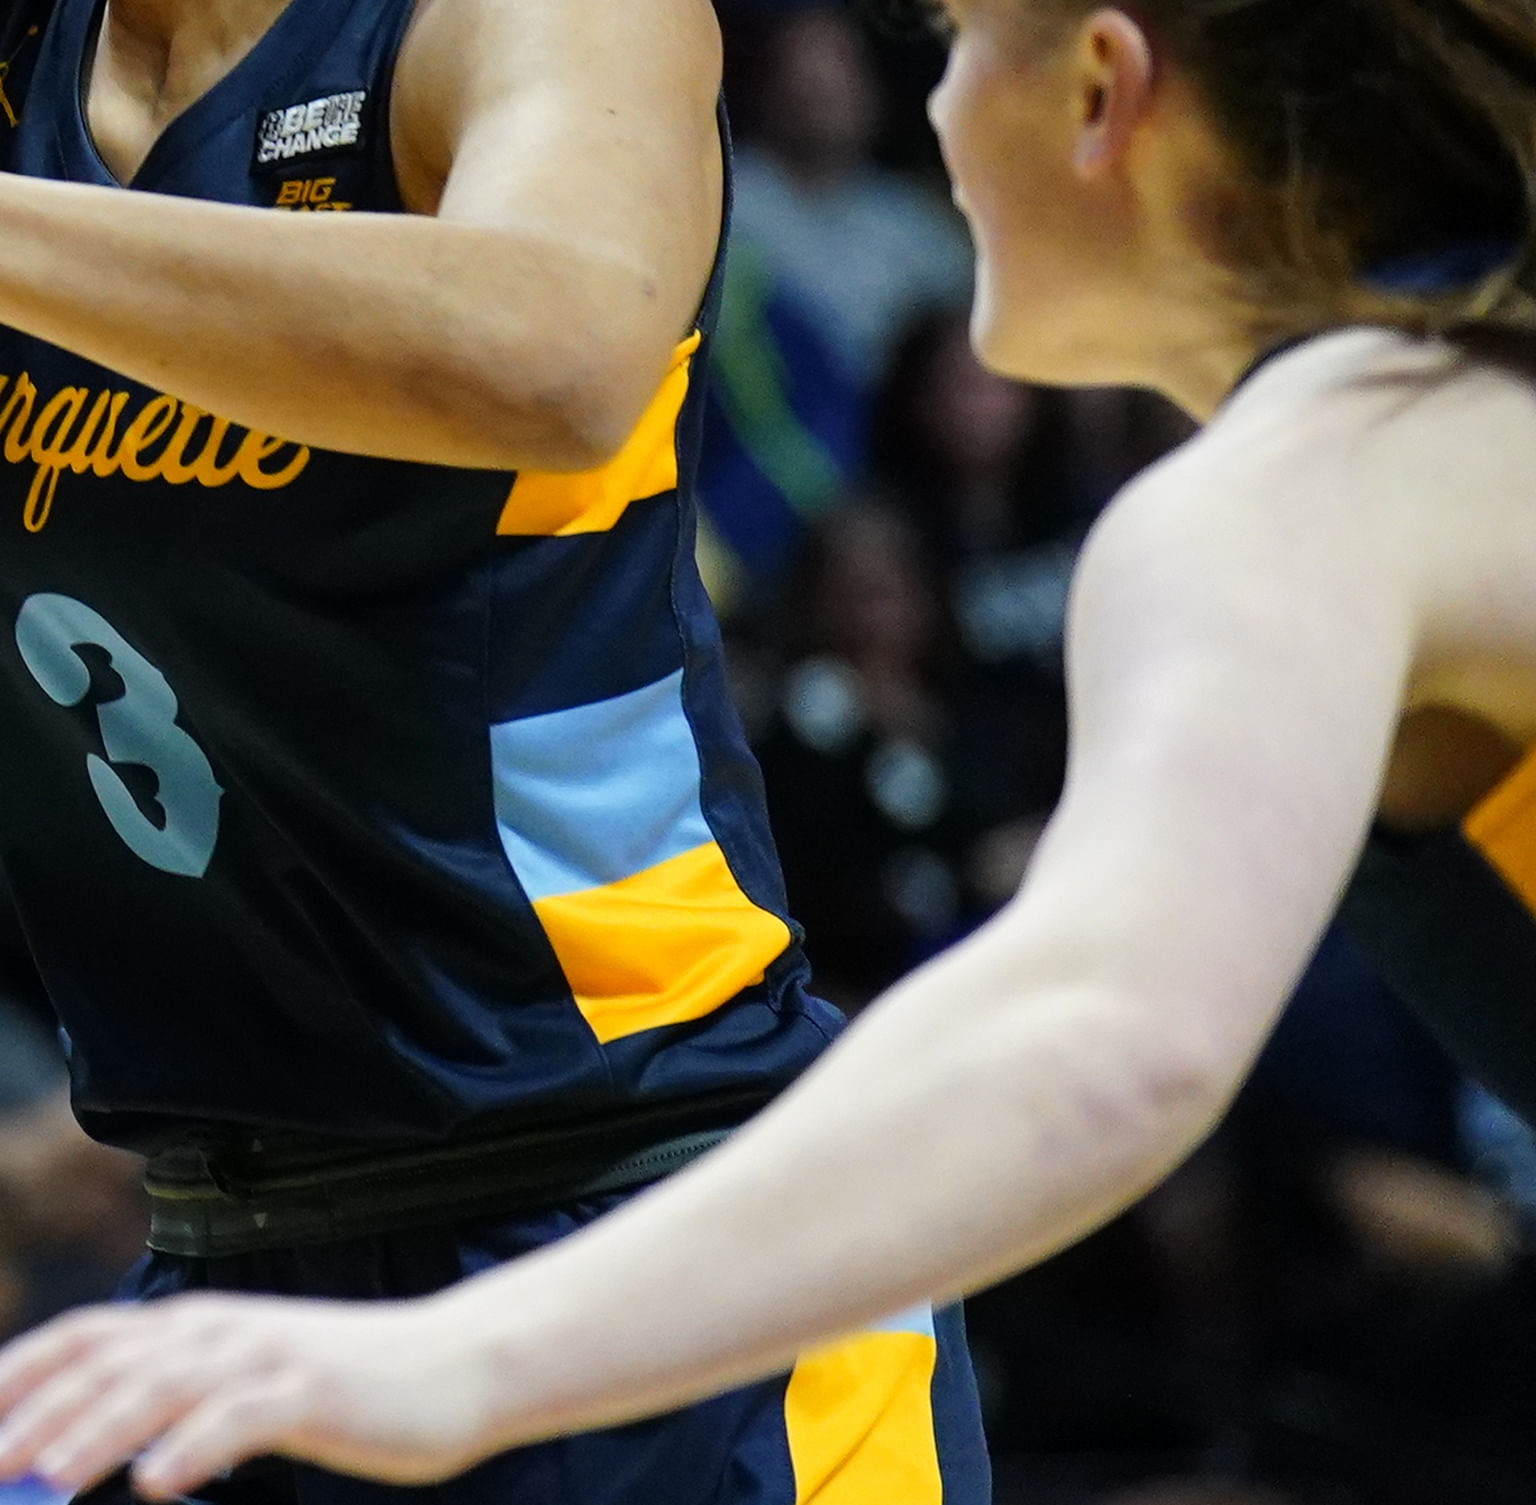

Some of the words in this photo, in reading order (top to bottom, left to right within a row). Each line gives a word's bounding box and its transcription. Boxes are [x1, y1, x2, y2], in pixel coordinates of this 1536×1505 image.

[257, 122, 359, 163] CHANGE
[275, 177, 336, 205] BIG
[14, 592, 226, 879] 3
